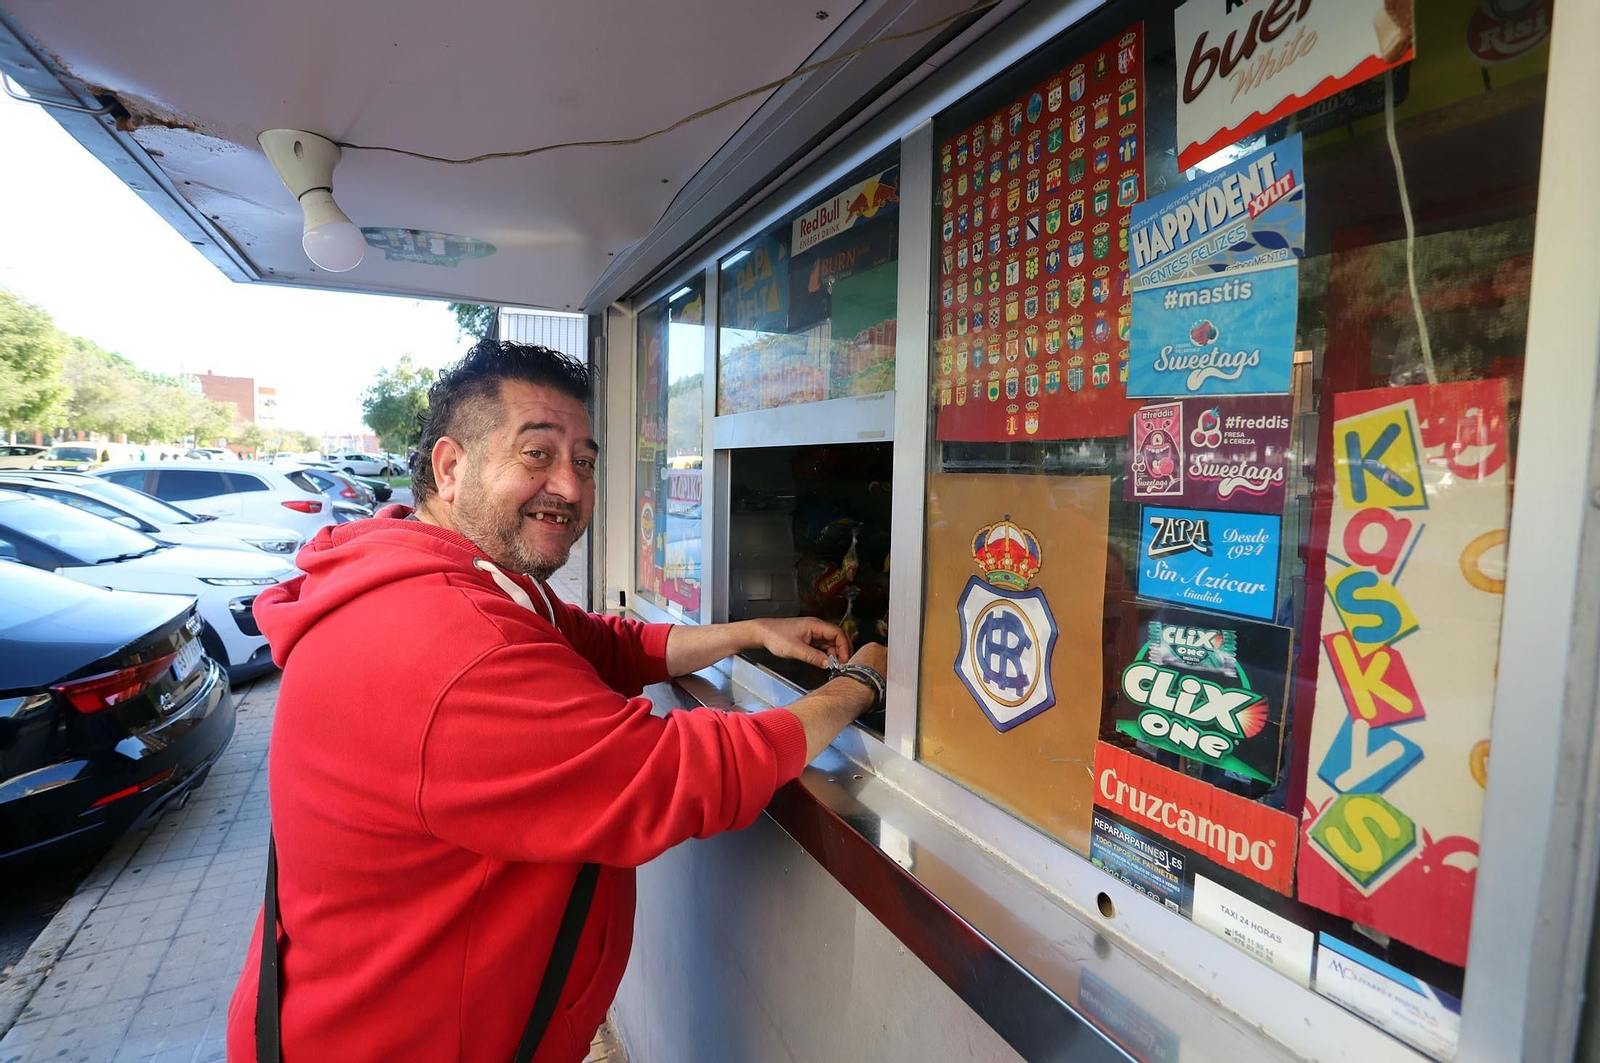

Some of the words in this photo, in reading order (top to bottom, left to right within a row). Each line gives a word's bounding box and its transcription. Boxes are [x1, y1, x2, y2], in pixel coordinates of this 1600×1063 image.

[1229, 25, 1318, 104] White
[1131, 151, 1278, 269] HAPPYDENT
[1251, 173, 1292, 216] XYLIT
[800, 213, 819, 238] Red
[819, 198, 841, 227] Bull
[800, 231, 821, 250] ENERGY
[821, 224, 840, 239] DRINK
[1190, 223, 1248, 264] FELIZES
[822, 250, 856, 277] BURN
[1141, 253, 1190, 286] DENTES
[1253, 248, 1288, 266] MENTA
[1164, 279, 1253, 310] #mastis
[1153, 345, 1260, 391] Sweetags
[1141, 408, 1174, 420] #freddis
[1225, 416, 1289, 429] #freddis
[1188, 453, 1284, 497] Sweetags
[1222, 528, 1270, 543] Desde
[1227, 544, 1264, 560] 1924
[1146, 560, 1178, 583] Sin
[1180, 566, 1268, 595] Azúcar
[1176, 587, 1223, 605] Añadido
[1100, 768, 1277, 872] Cruzcampo
[1096, 834, 1112, 848] TODO
[1113, 843, 1132, 858] TIPOS
[1132, 854, 1142, 863] DE
[1142, 860, 1179, 883] PATINETES
[1220, 905, 1239, 920] TAXI
[1239, 915, 1249, 926] 24
[1251, 922, 1282, 944] HORAS
